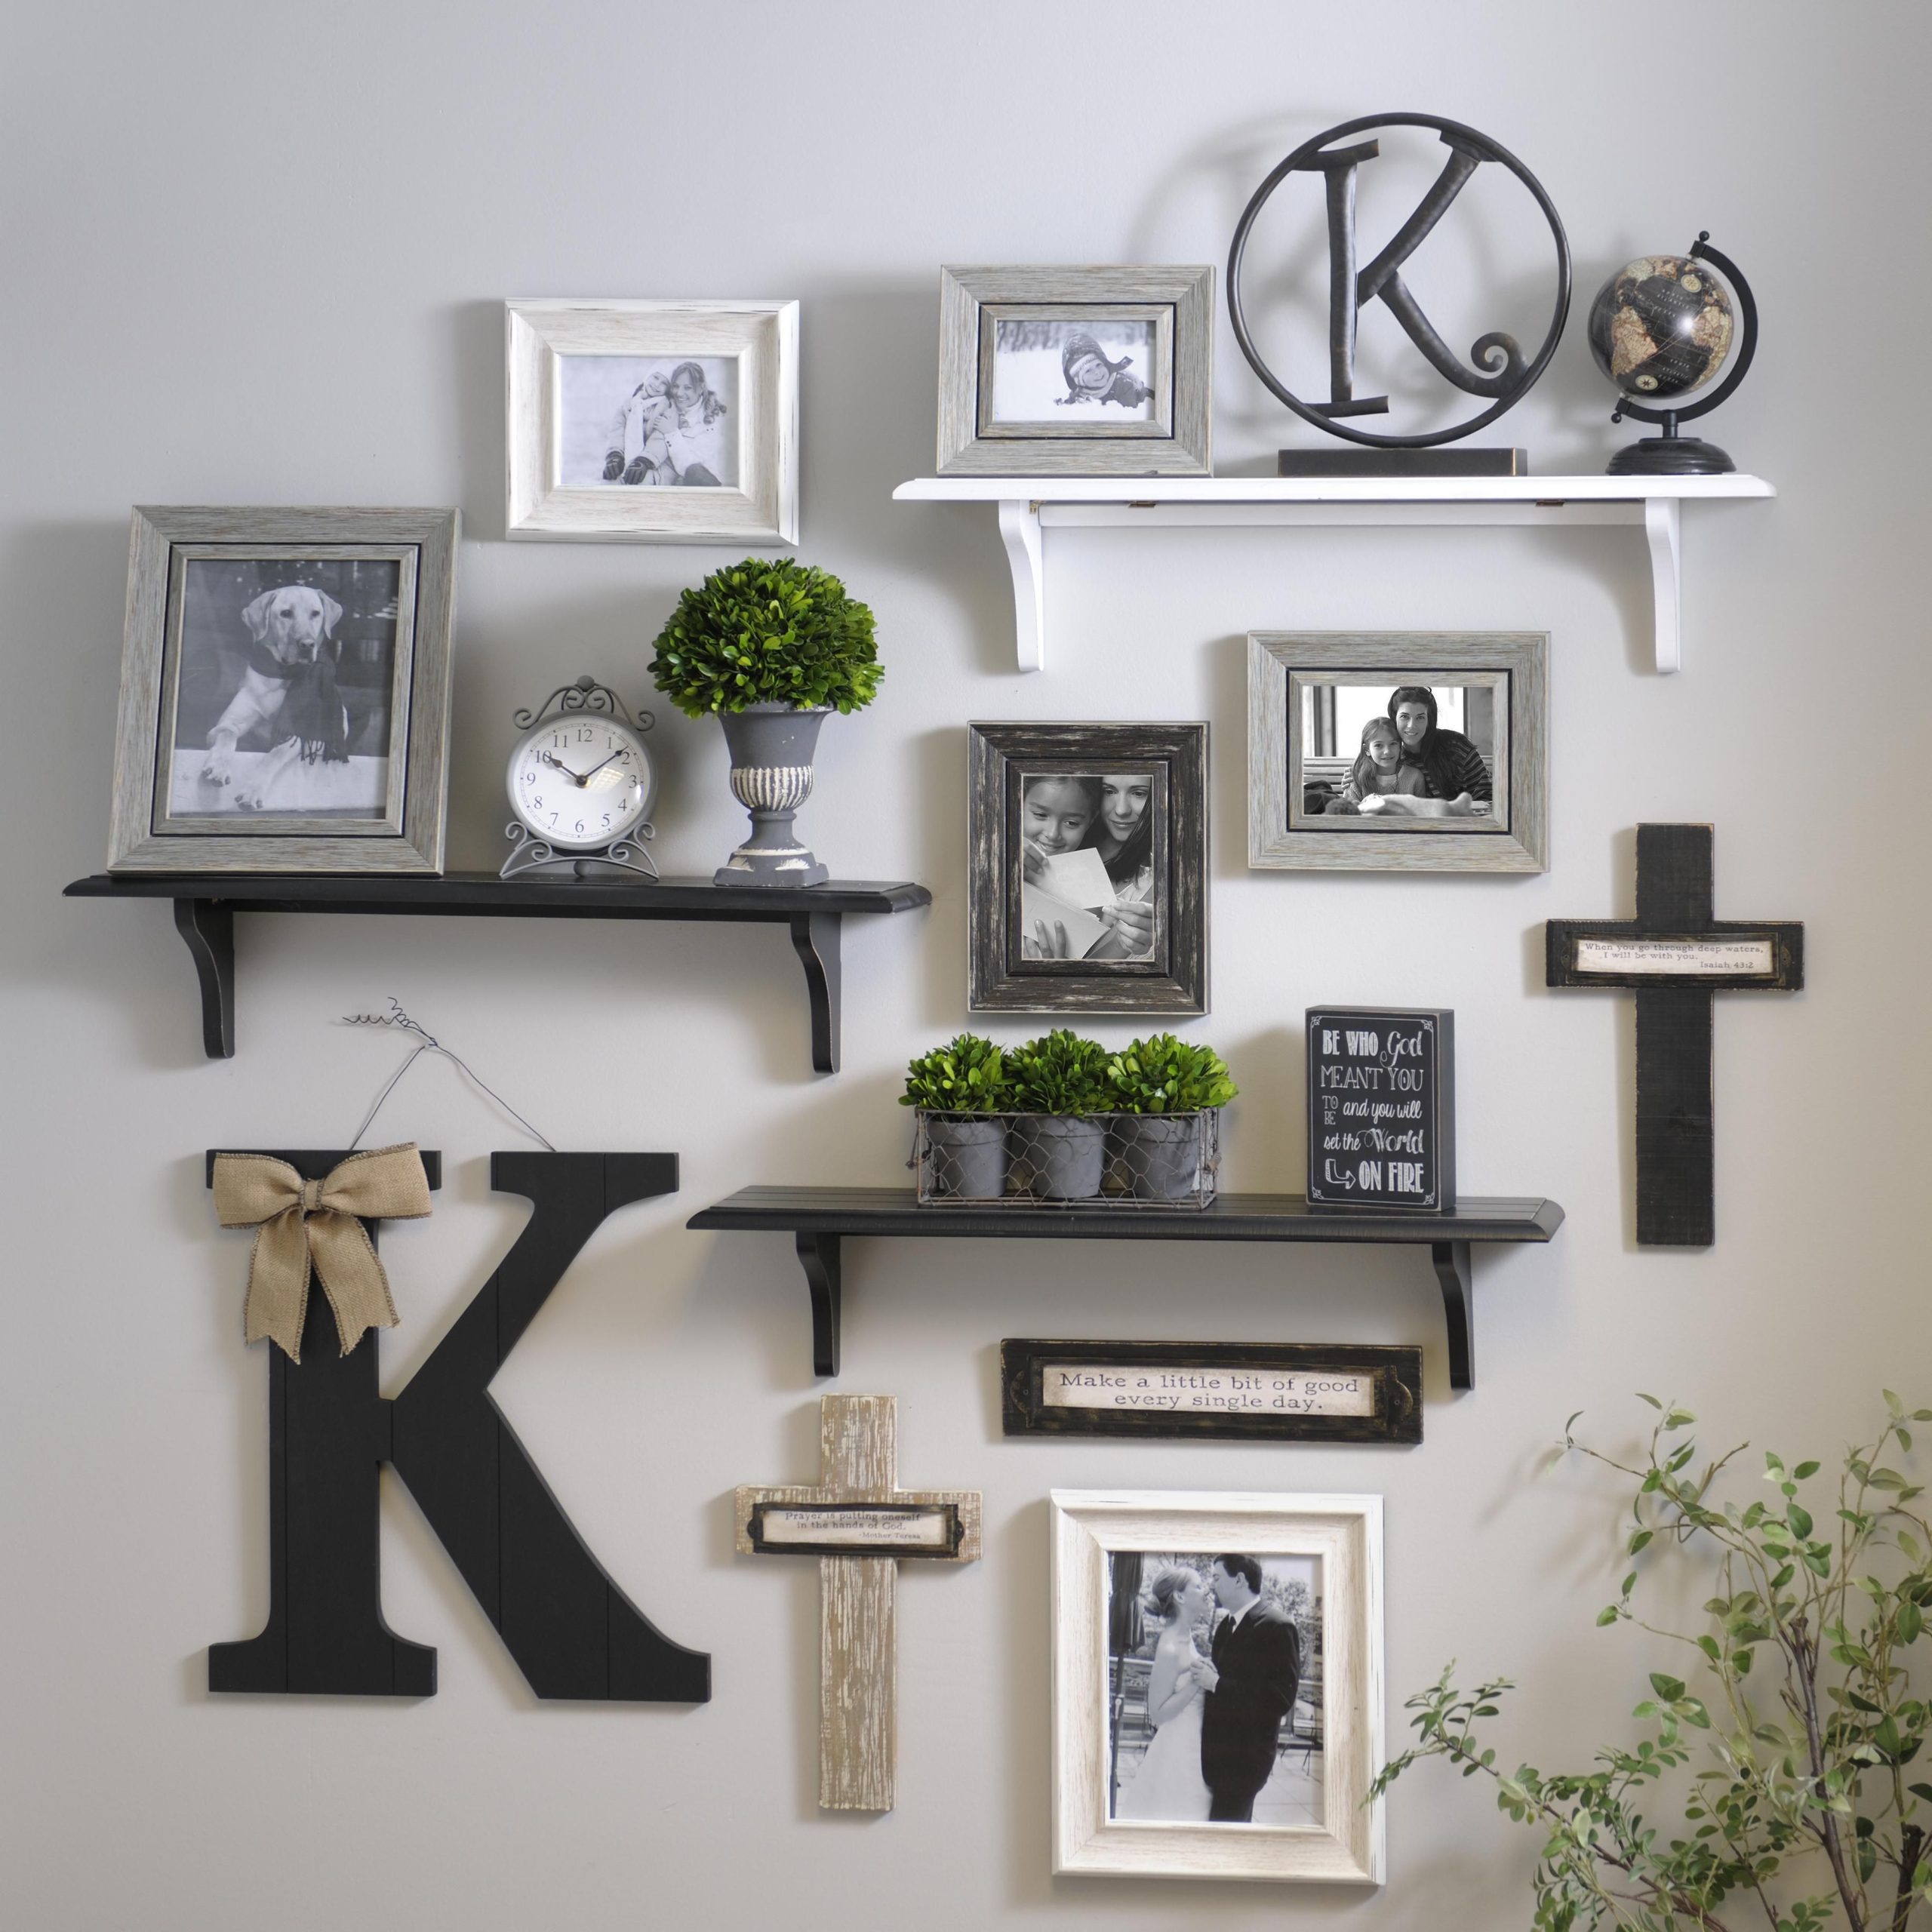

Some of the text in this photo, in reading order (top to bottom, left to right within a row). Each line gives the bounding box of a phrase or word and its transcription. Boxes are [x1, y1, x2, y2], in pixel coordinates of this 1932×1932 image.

[553, 735, 568, 748] 11
[577, 729, 592, 743] 12
[607, 737, 612, 749] 1
[536, 750, 552, 763] 10
[621, 752, 630, 764] 2
[527, 773, 536, 786] 9
[629, 775, 637, 789] 3
[534, 796, 543, 809] 8
[617, 798, 627, 811] 4
[549, 813, 558, 826] 7
[575, 820, 584, 832] 6
[601, 814, 610, 827] 5
[1654, 944, 1694, 953] through
[1697, 945, 1721, 953] deep
[1322, 1030, 1423, 1069] BE WHO God
[1321, 1065, 1424, 1091] MEANT YOU
[1322, 1096, 1339, 1109] TO
[1343, 1099, 1422, 1124] and you will
[1324, 1112, 1336, 1125] BE
[1323, 1128, 1425, 1155] set the World
[1358, 1160, 1425, 1193] ON FIRE
[1060, 1373, 1359, 1395] Make a little bit of good
[1114, 1394, 1324, 1412] every single day.
[205, 1149, 712, 1704] K
[786, 1512, 823, 1521] Prayer
[840, 1512, 878, 1522] putting
[881, 1513, 920, 1521] oneself
[832, 1521, 864, 1529] hands
[868, 1521, 878, 1529] of
[881, 1521, 906, 1531] God.
